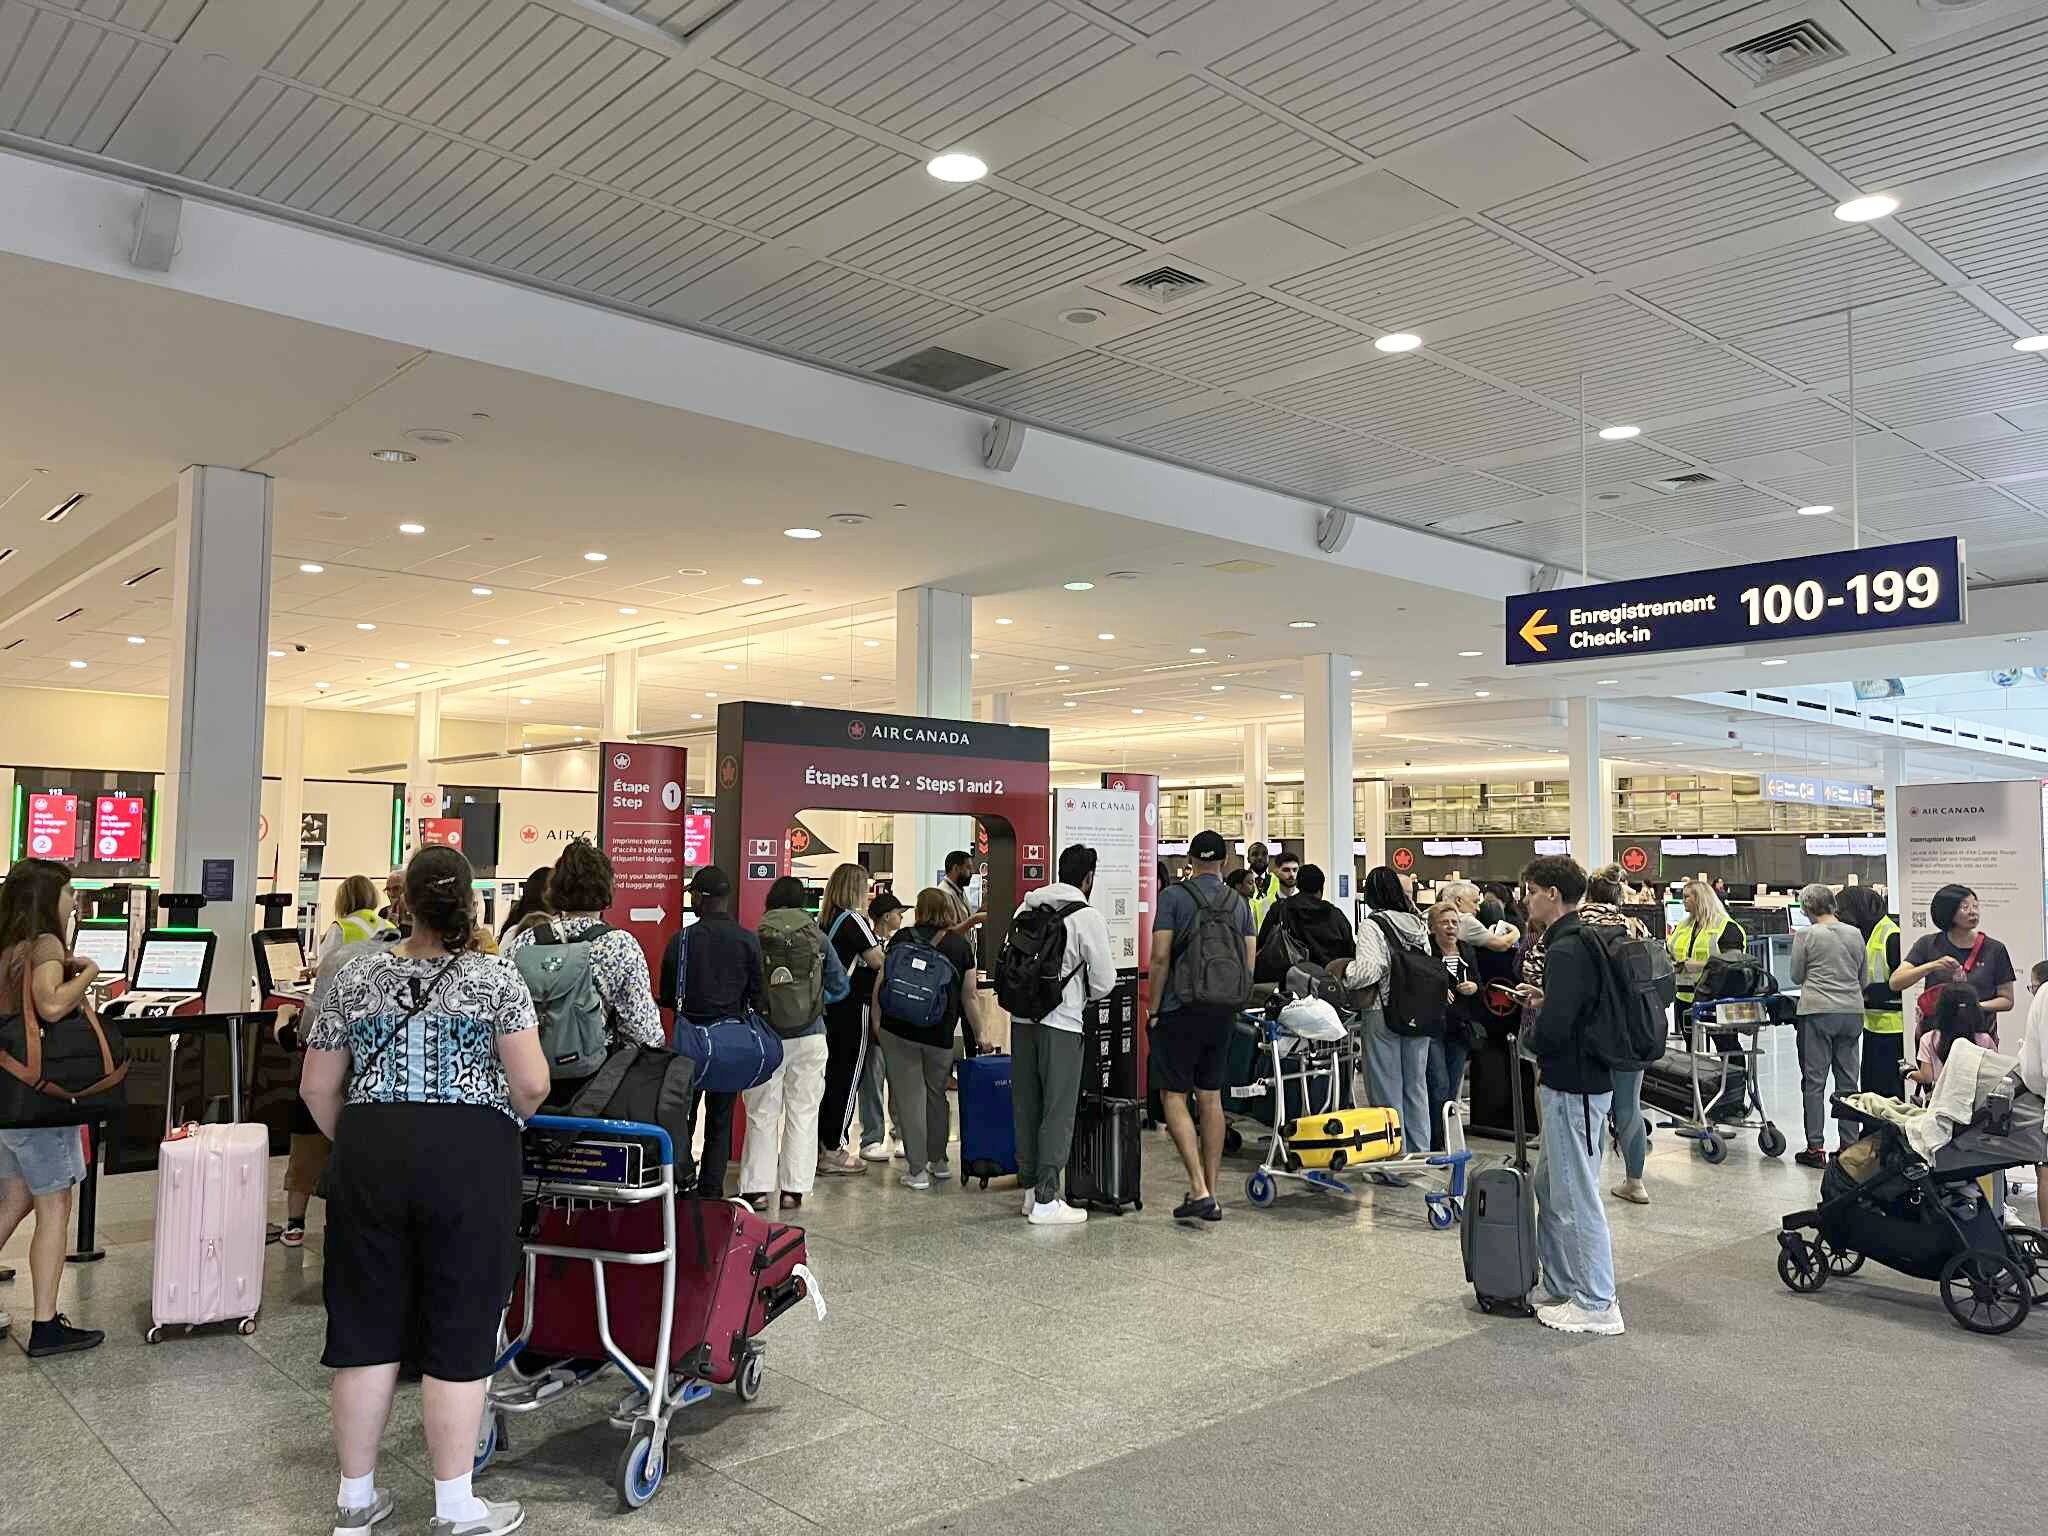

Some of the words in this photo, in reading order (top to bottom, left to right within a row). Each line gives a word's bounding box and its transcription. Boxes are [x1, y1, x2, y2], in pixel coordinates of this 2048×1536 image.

[1740, 566, 1940, 626] 100-199
[1569, 593, 1716, 625] Enregistrement
[1569, 627, 1651, 650] Check-in
[872, 725, 899, 740] AIR
[903, 727, 970, 746] CANADA
[613, 778, 650, 795] Étape
[805, 764, 858, 788] Étapes
[861, 772, 869, 788] 1
[872, 776, 887, 789] et
[889, 774, 900, 790] 2
[915, 775, 955, 795] Steps
[957, 778, 965, 793] 1
[967, 778, 992, 794] and
[994, 780, 1004, 795] 2
[612, 796, 643, 810] Step
[669, 789, 675, 803] 1
[1080, 800, 1098, 810] AIR
[1100, 802, 1136, 812] CANADA
[1922, 807, 1939, 816] AIR
[1940, 806, 1986, 815] CANADA
[546, 829, 575, 841] AIR
